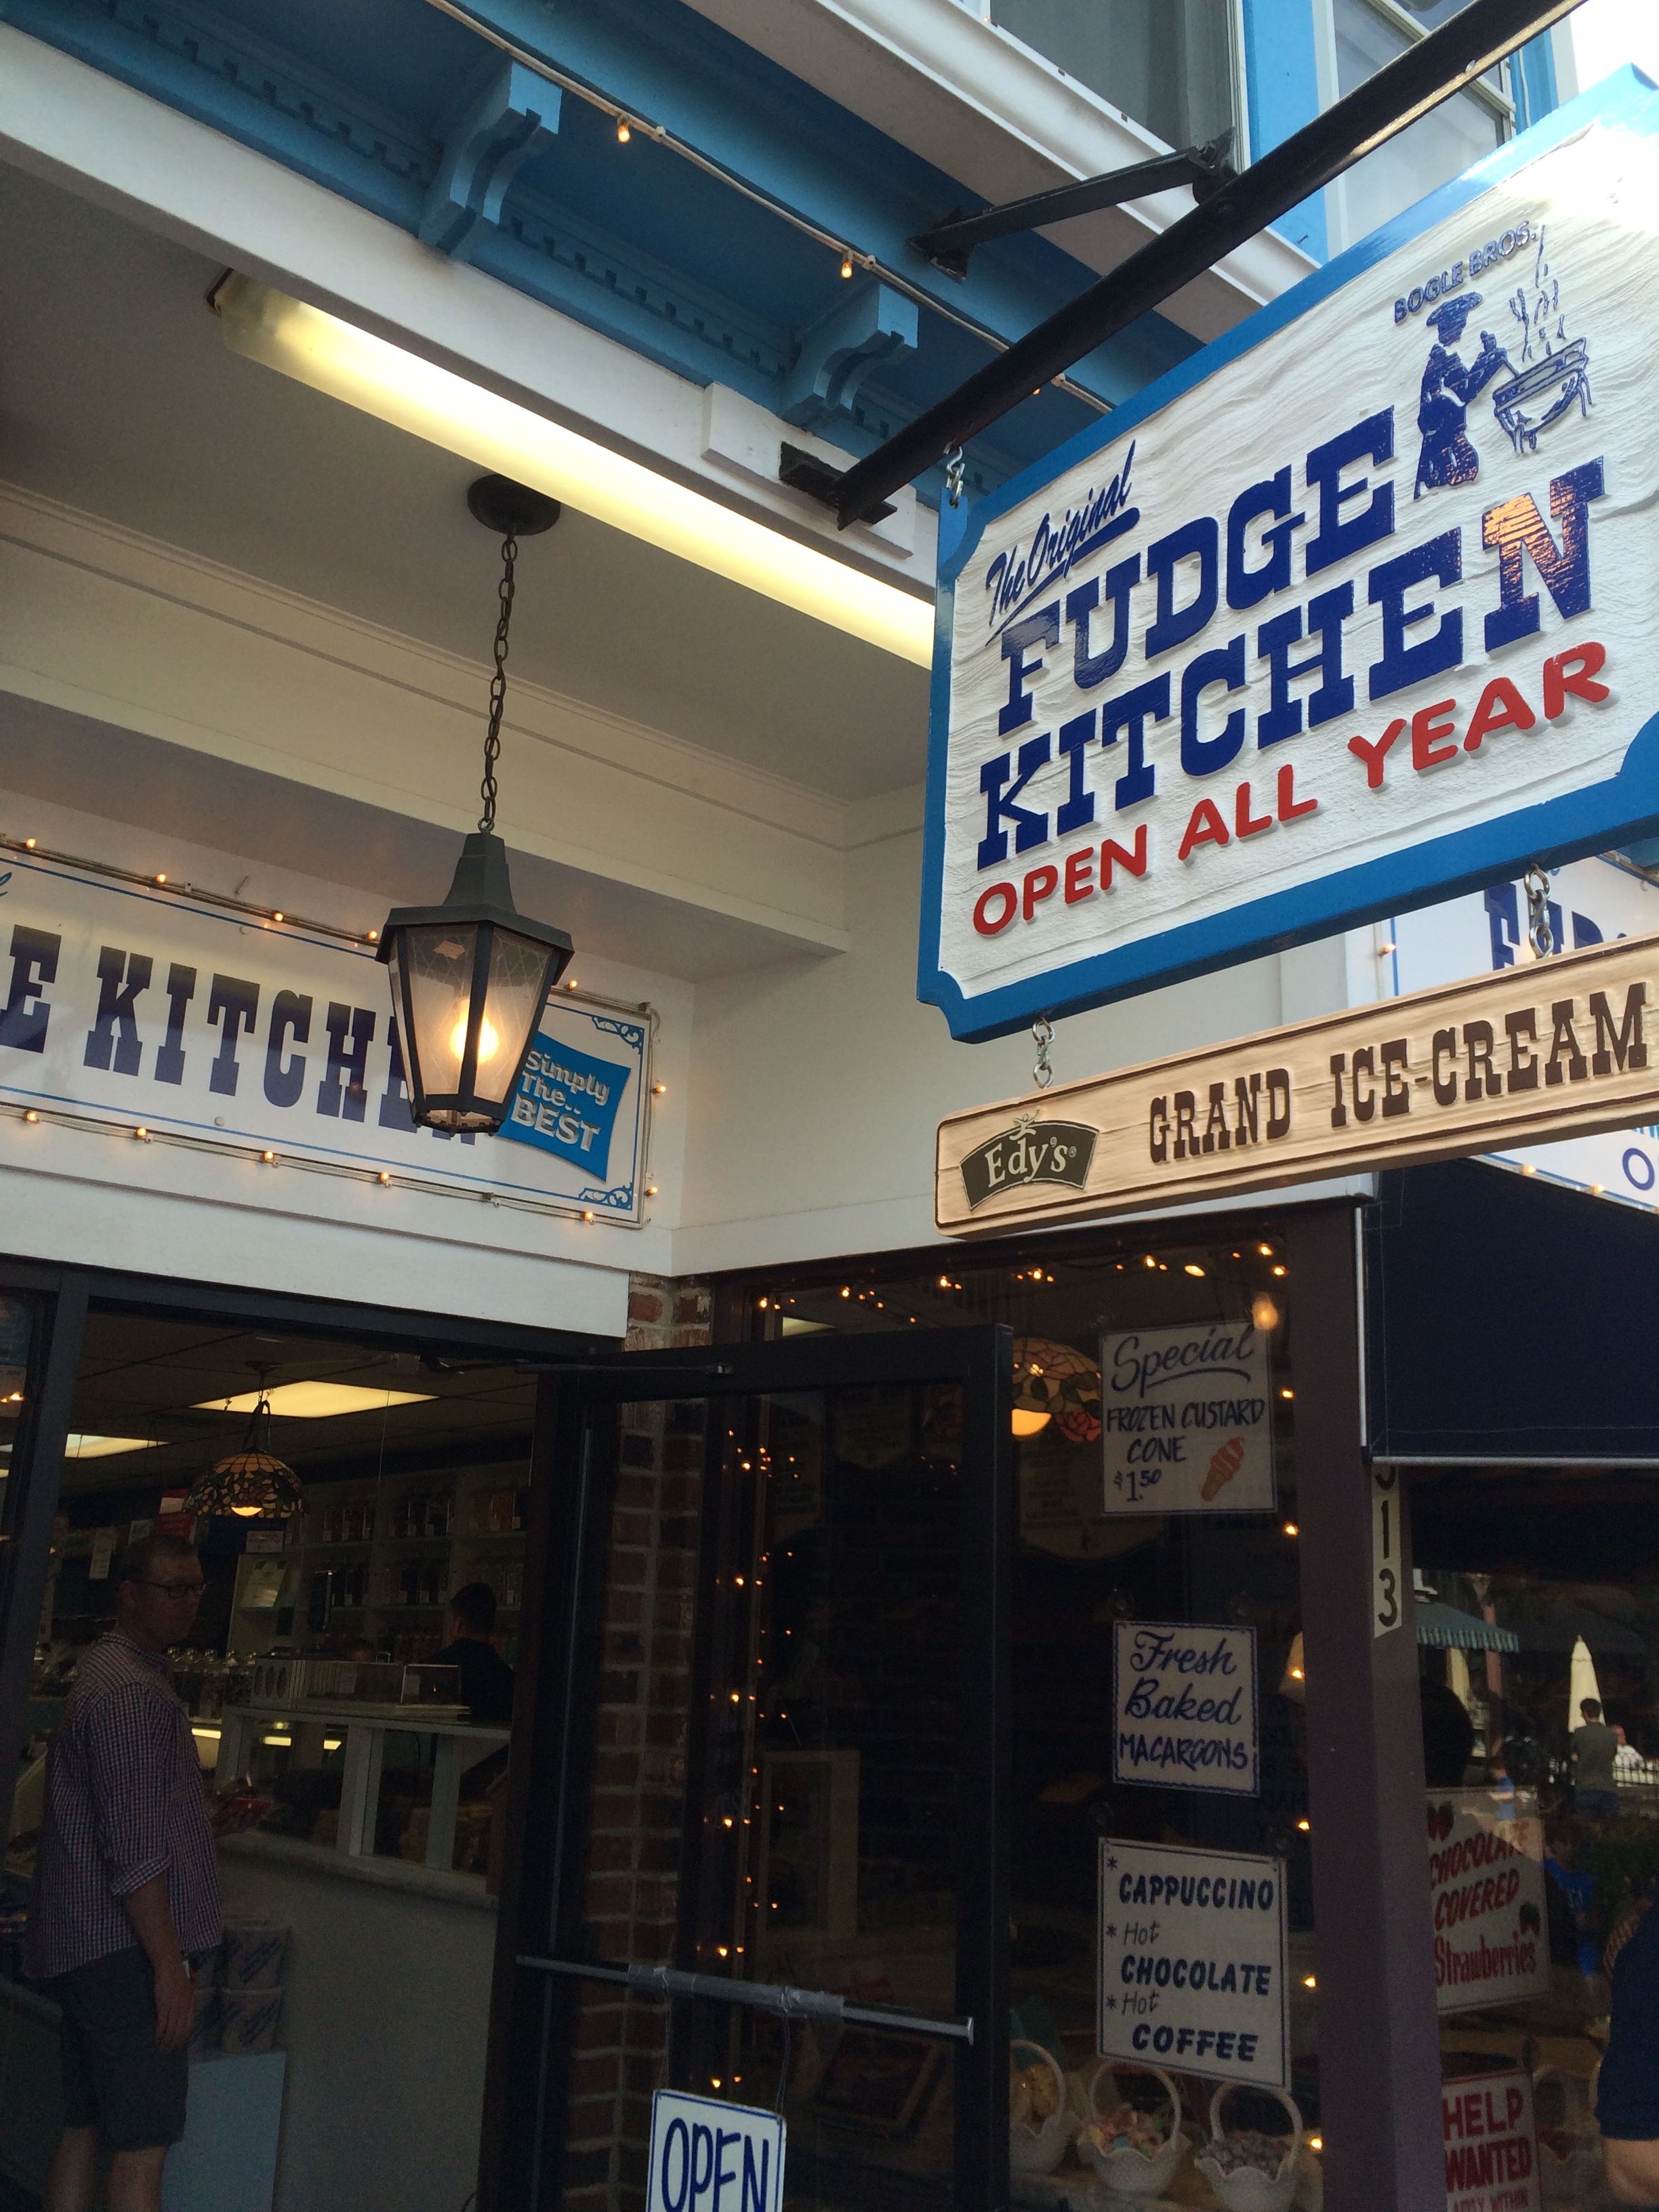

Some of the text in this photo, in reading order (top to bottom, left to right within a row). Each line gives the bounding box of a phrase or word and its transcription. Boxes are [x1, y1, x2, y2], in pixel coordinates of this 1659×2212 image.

[1394, 220, 1536, 324] BOGLE BROS.
[985, 438, 1136, 626] The Original
[998, 405, 1396, 737] FUDGE
[977, 455, 1605, 871] KITCHEN
[972, 640, 1611, 936] OPEN ALL YEAR
[525, 1049, 610, 1107] Simply
[1150, 982, 1648, 1163] GRAND ICE-CREAM
[510, 1092, 601, 1152] BEST
[1111, 1323, 1256, 1399] Special
[1106, 1398, 1265, 1433] FROZEN CUSTARD
[1126, 1435, 1187, 1465] CONE
[1129, 1630, 1237, 1676] Fresh
[1124, 1677, 1243, 1725] Baked
[1119, 1733, 1249, 1771] MACAROONS
[1118, 1872, 1275, 1912] CAPPUCCINO
[1434, 1868, 1520, 1931] COVERED
[1123, 1919, 1161, 1946] Hot
[1433, 1930, 1536, 1986] Strawberries
[1120, 1954, 1272, 1996] CHOCOLATE
[1121, 1989, 1161, 2015] Hot
[1132, 2022, 1259, 2063] COFFEE
[1441, 2087, 1523, 2141] HELP
[661, 2117, 769, 2212] OPEN
[1443, 2136, 1531, 2194] WANTED
